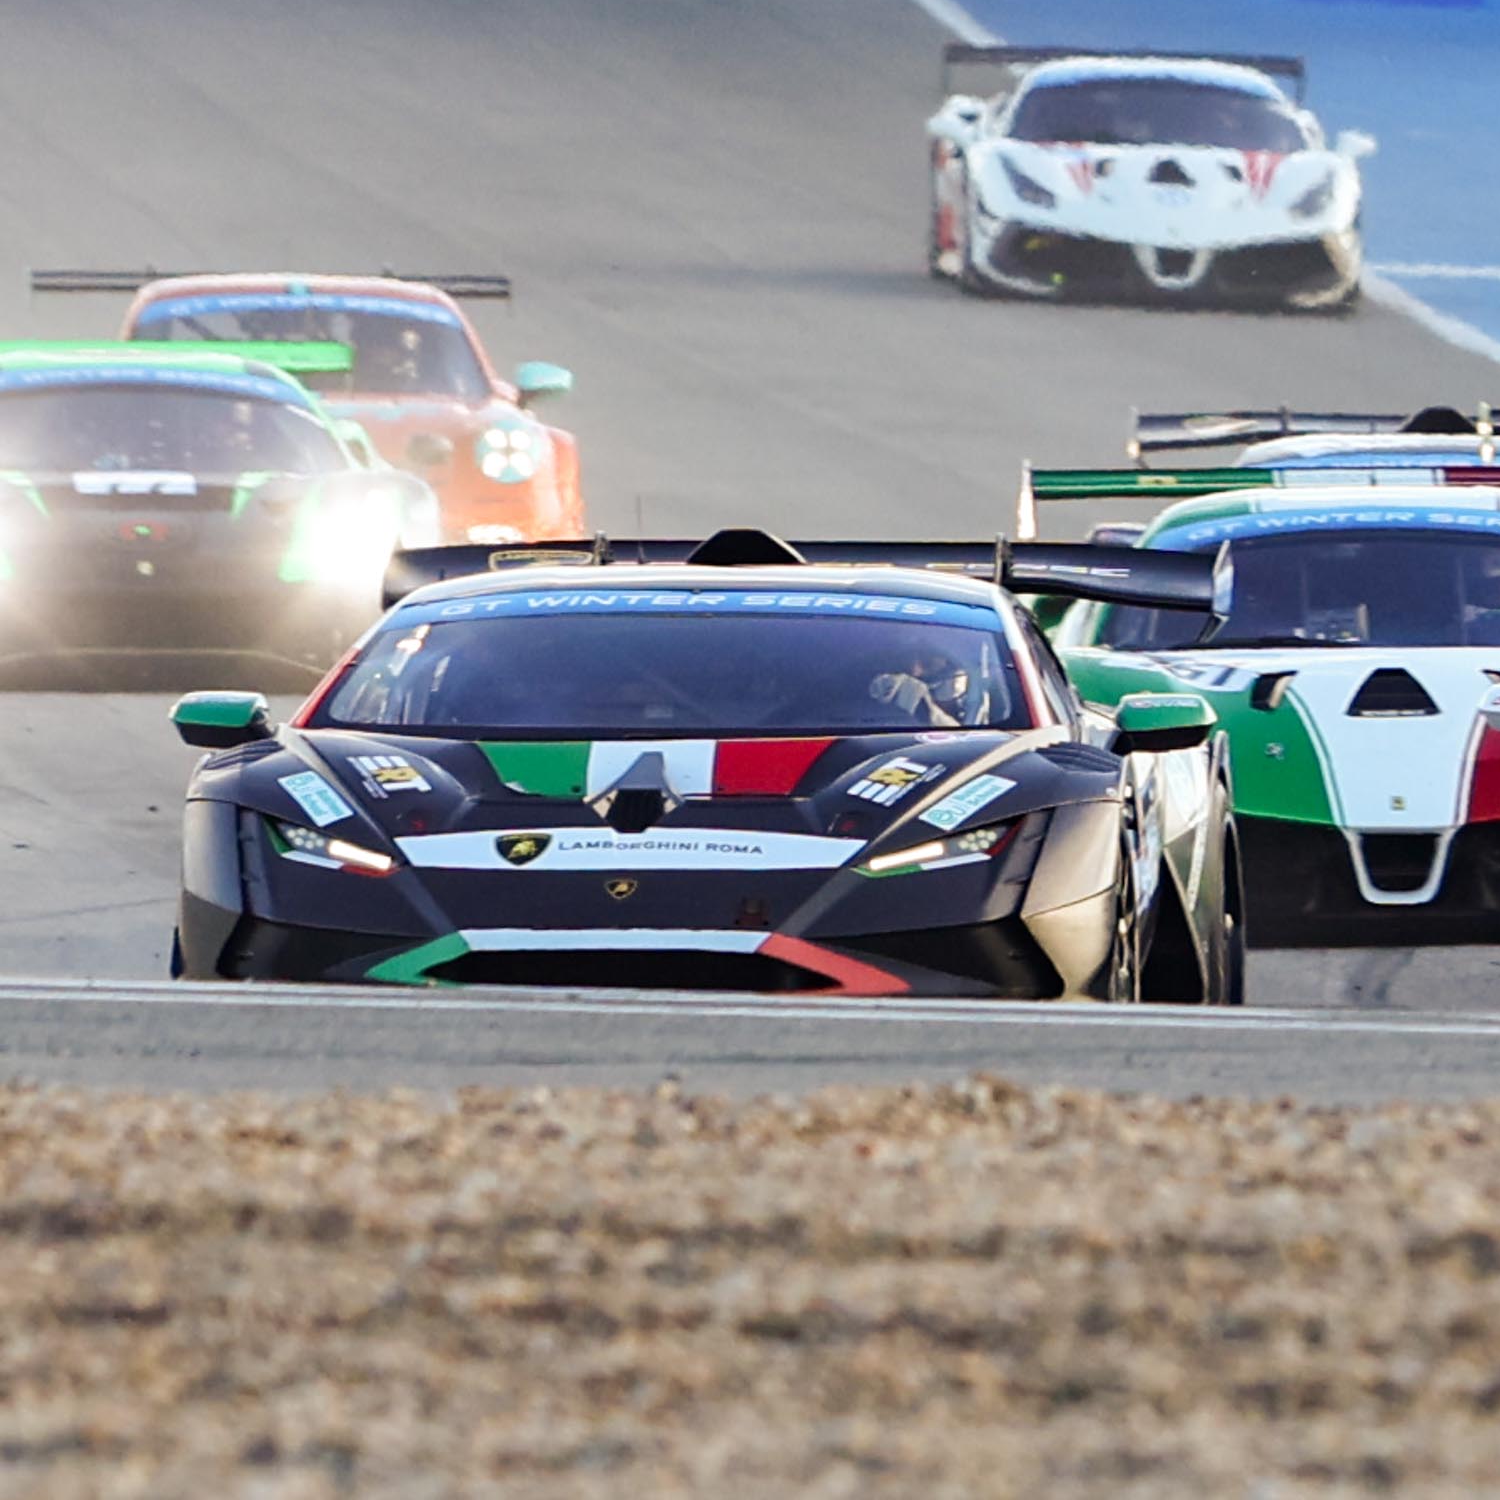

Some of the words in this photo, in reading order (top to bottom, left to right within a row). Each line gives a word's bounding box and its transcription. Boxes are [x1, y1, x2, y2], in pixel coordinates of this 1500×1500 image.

[1186, 521, 1245, 542] GT
[1255, 511, 1416, 529] WINTER
[440, 599, 512, 617] GT
[526, 592, 727, 609] WINTER
[740, 593, 937, 616] SERIES
[557, 840, 700, 853] LAMBORGHINI
[704, 841, 764, 855] ROMA
